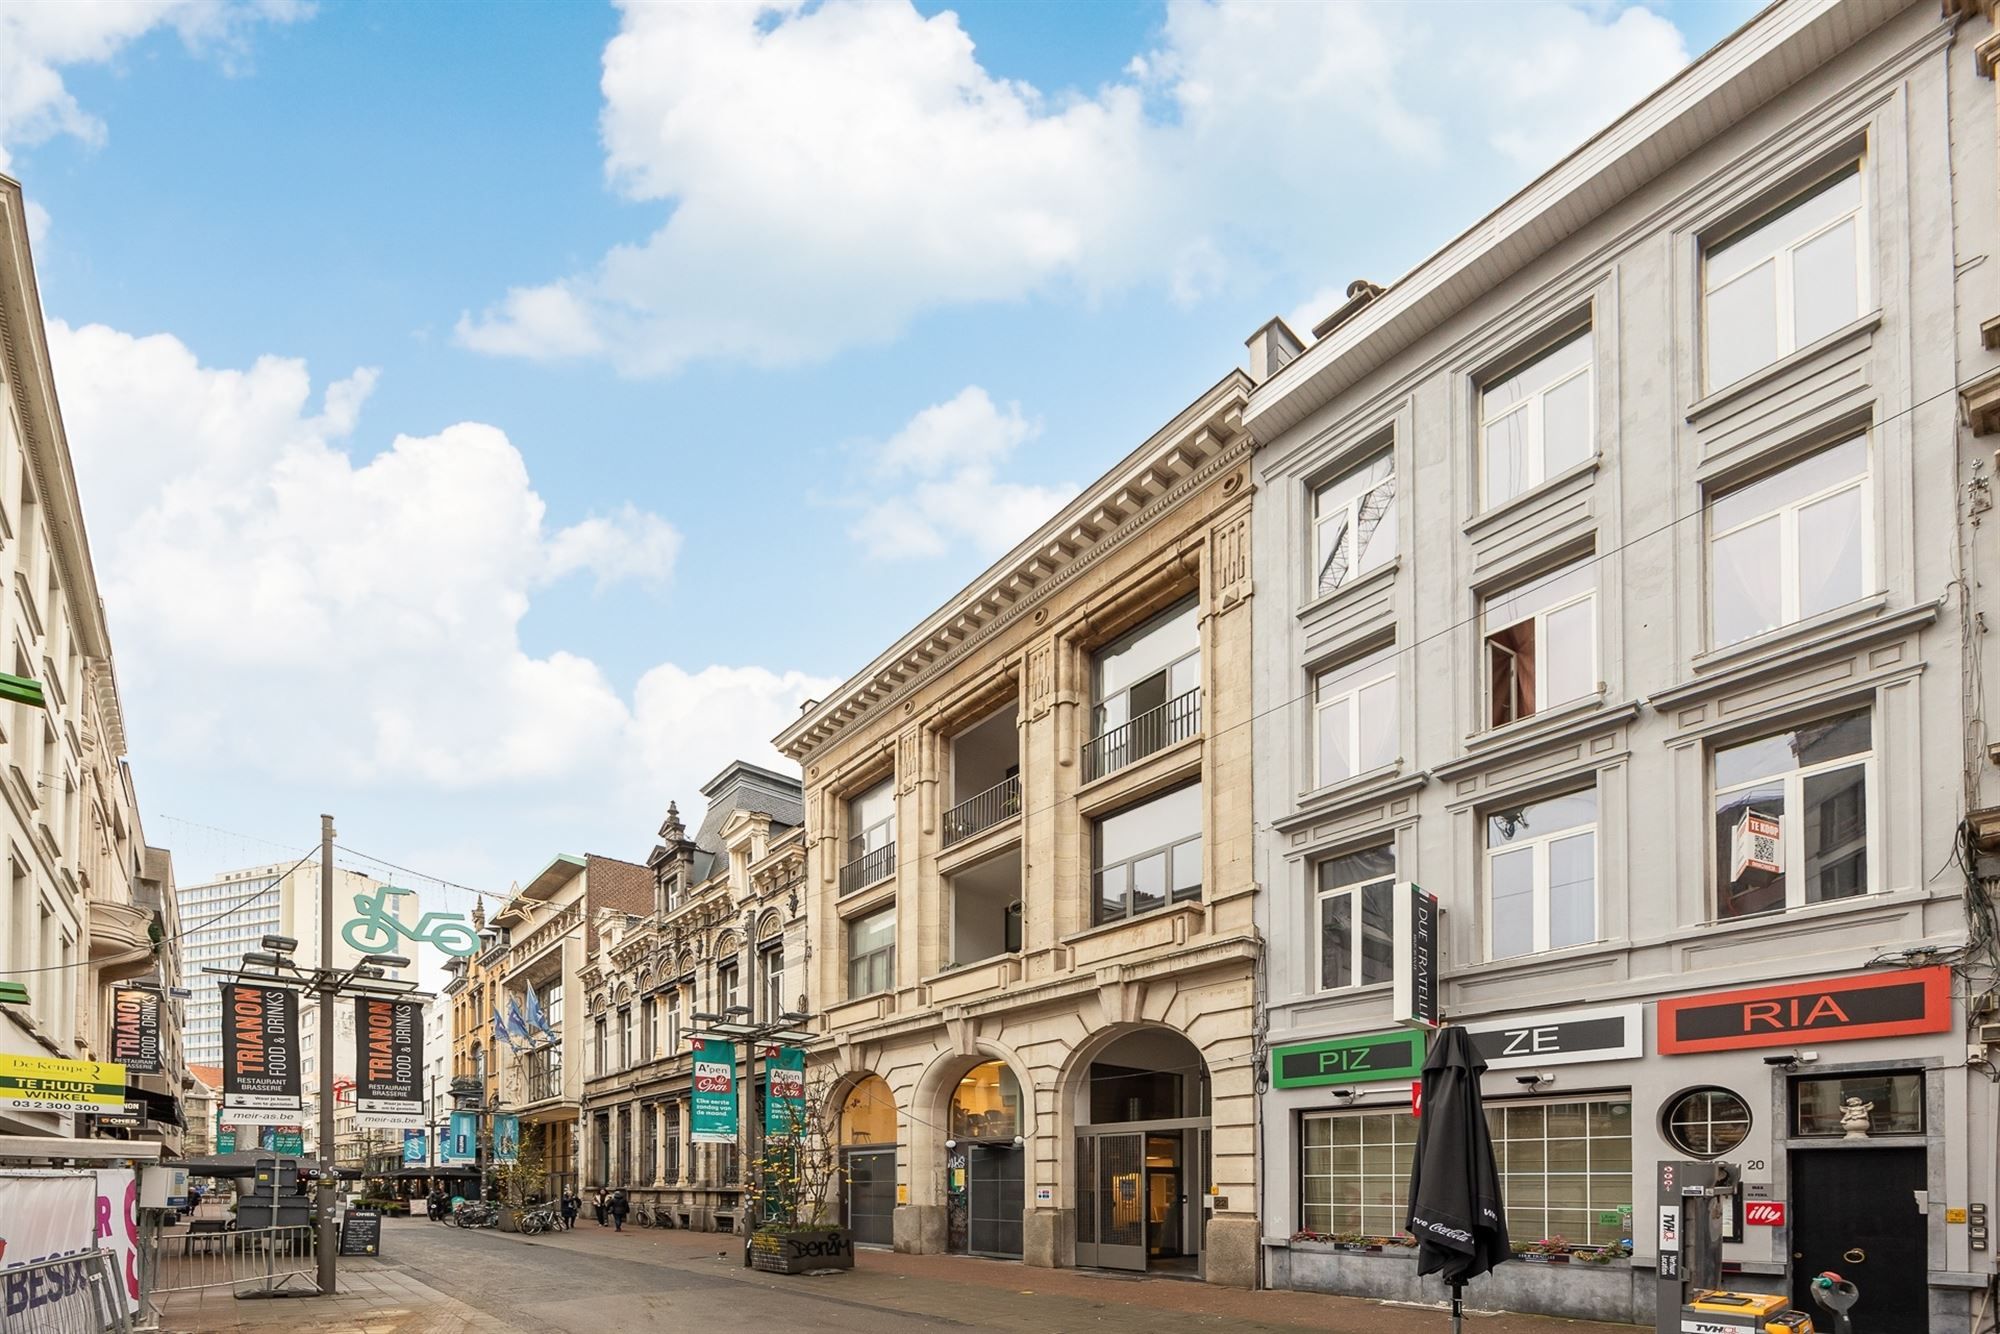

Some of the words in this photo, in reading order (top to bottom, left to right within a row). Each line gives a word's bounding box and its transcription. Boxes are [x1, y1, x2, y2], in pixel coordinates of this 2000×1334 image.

[1418, 907, 1428, 943] DUE
[1418, 946, 1428, 1017] FRATELLI
[141, 994, 157, 1027] DRINKS
[266, 991, 285, 1034] DRINKS
[1743, 995, 1850, 1032] RIA
[116, 991, 141, 1057] TRIANON
[234, 988, 265, 1074] TRIANON
[396, 1005, 412, 1043] DRINKS
[141, 1036, 157, 1059] FOOD
[368, 1001, 393, 1081] TRIANON
[1502, 1026, 1560, 1055] ZE
[268, 1046, 287, 1076] FOOD
[396, 1055, 412, 1083] FOOD
[1319, 1048, 1371, 1073] PIZ
[16, 1078, 37, 1089] TE
[41, 1080, 96, 1093] HUUR
[237, 1077, 287, 1086] RESTAURANT
[368, 1083, 412, 1091] RESTAURANT
[698, 1079, 727, 1092] Open
[12, 1100, 30, 1108] 03
[46, 1102, 72, 1110] 300
[24, 1090, 90, 1102] WINKEL
[233, 1112, 295, 1120] meir-as.be
[364, 1115, 417, 1123] meir-as.be
[1747, 1159, 1765, 1170] 20
[1663, 1214, 1675, 1232] TVH
[1748, 1205, 1782, 1224] illy
[1661, 1254, 1669, 1276] Location
[1696, 1323, 1724, 1333] TVH
